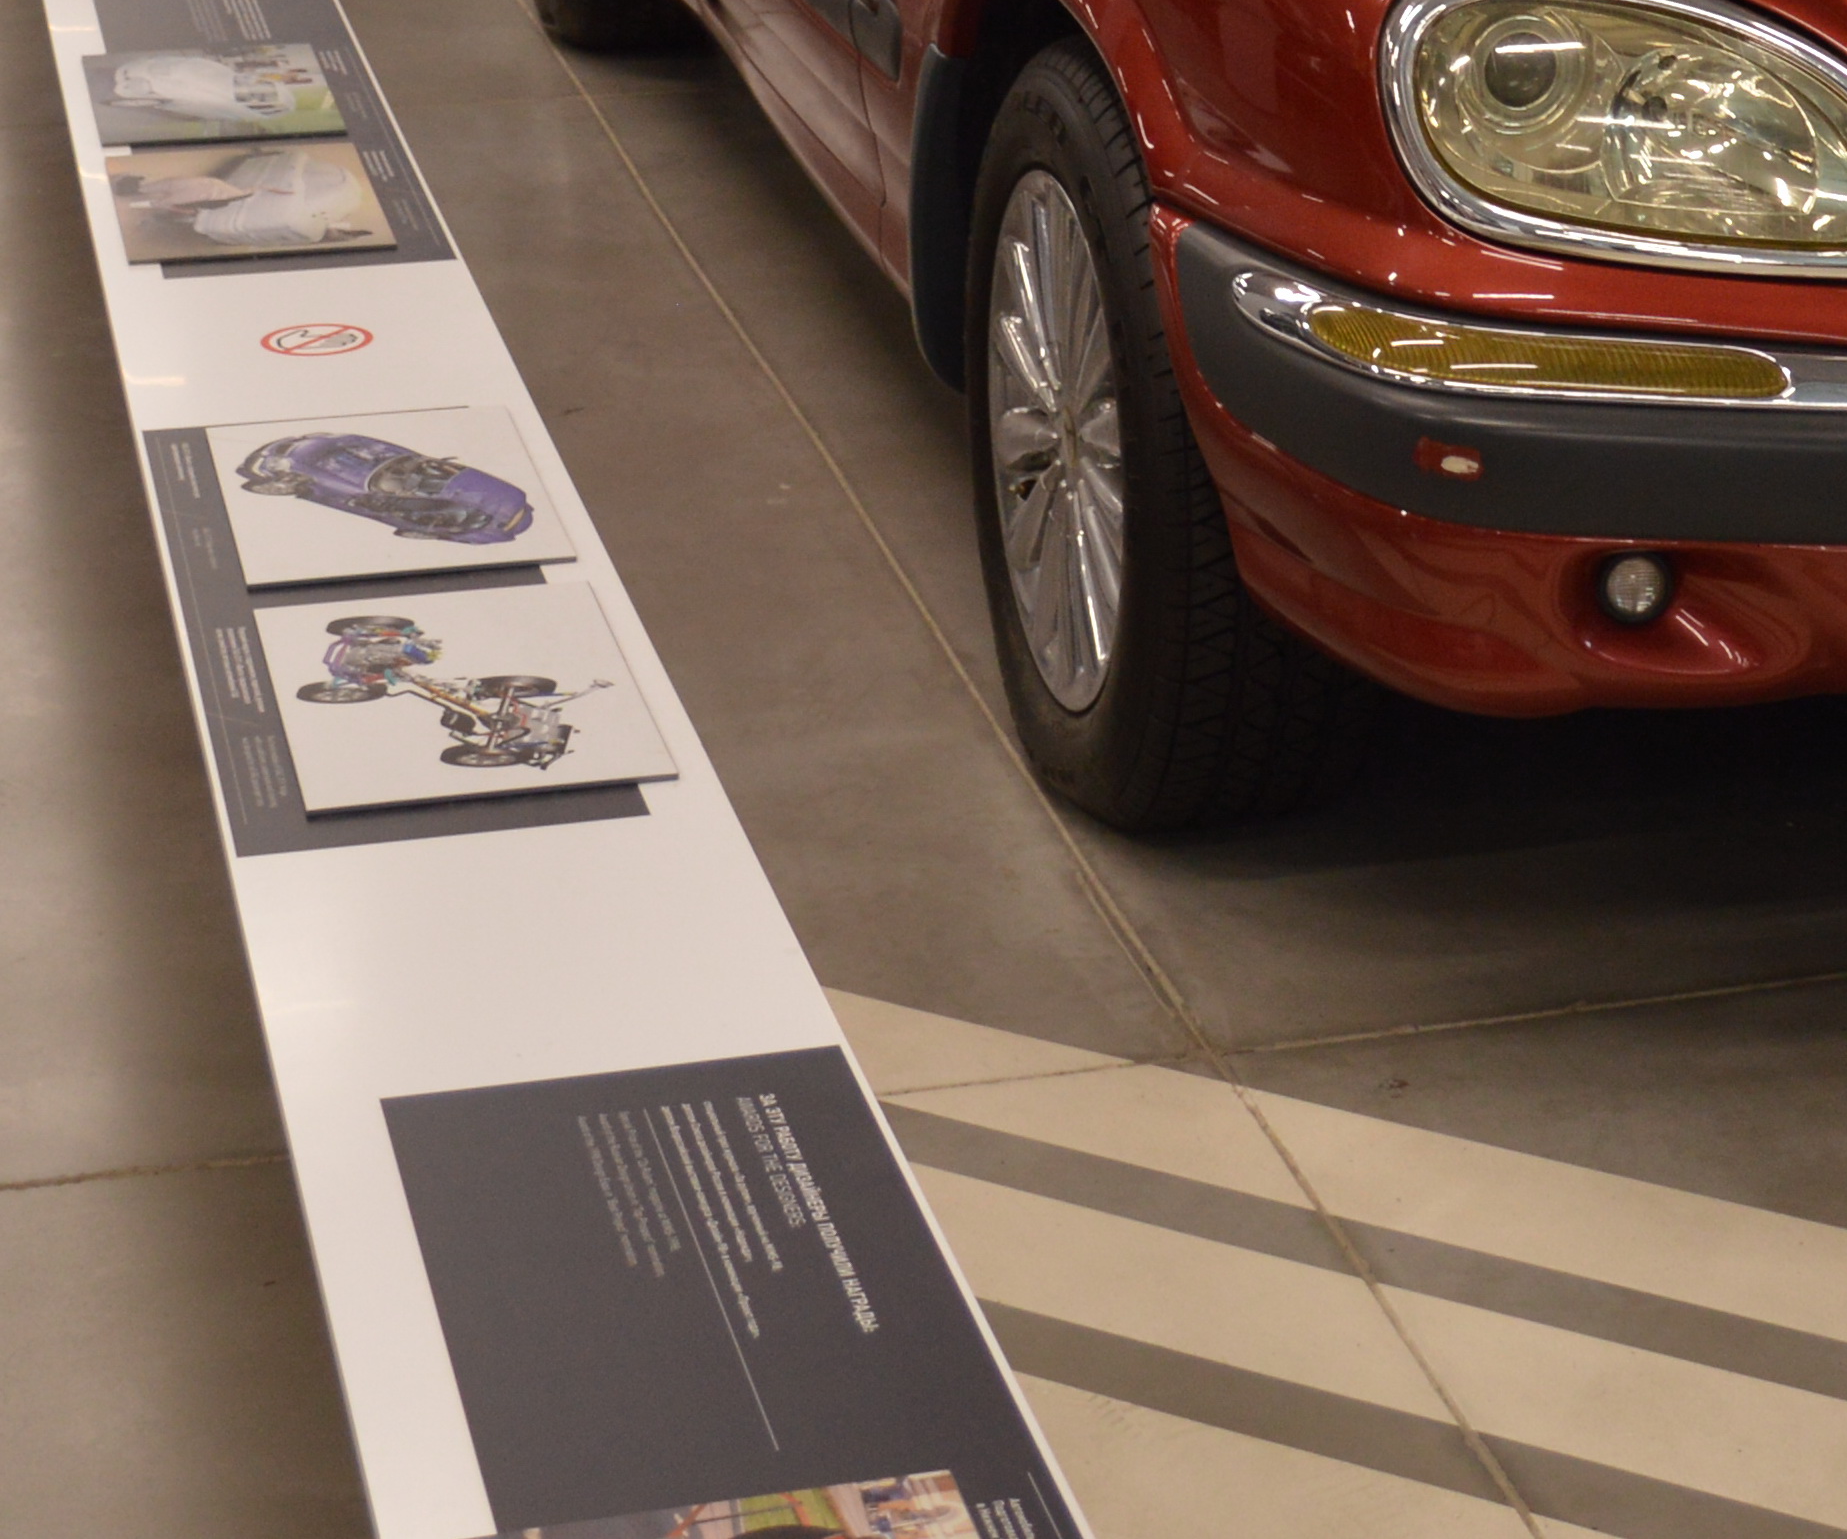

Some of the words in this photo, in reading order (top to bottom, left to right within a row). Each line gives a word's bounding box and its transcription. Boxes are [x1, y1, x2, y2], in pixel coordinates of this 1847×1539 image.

[758, 1092, 778, 1108] ЗА
[765, 1107, 786, 1125] ЭТУ
[774, 1125, 804, 1161] РАБОТУ
[786, 1161, 832, 1222] ДИЗАЙНЕРЫ
[817, 1222, 856, 1278] ПОЛУЧИЛИ
